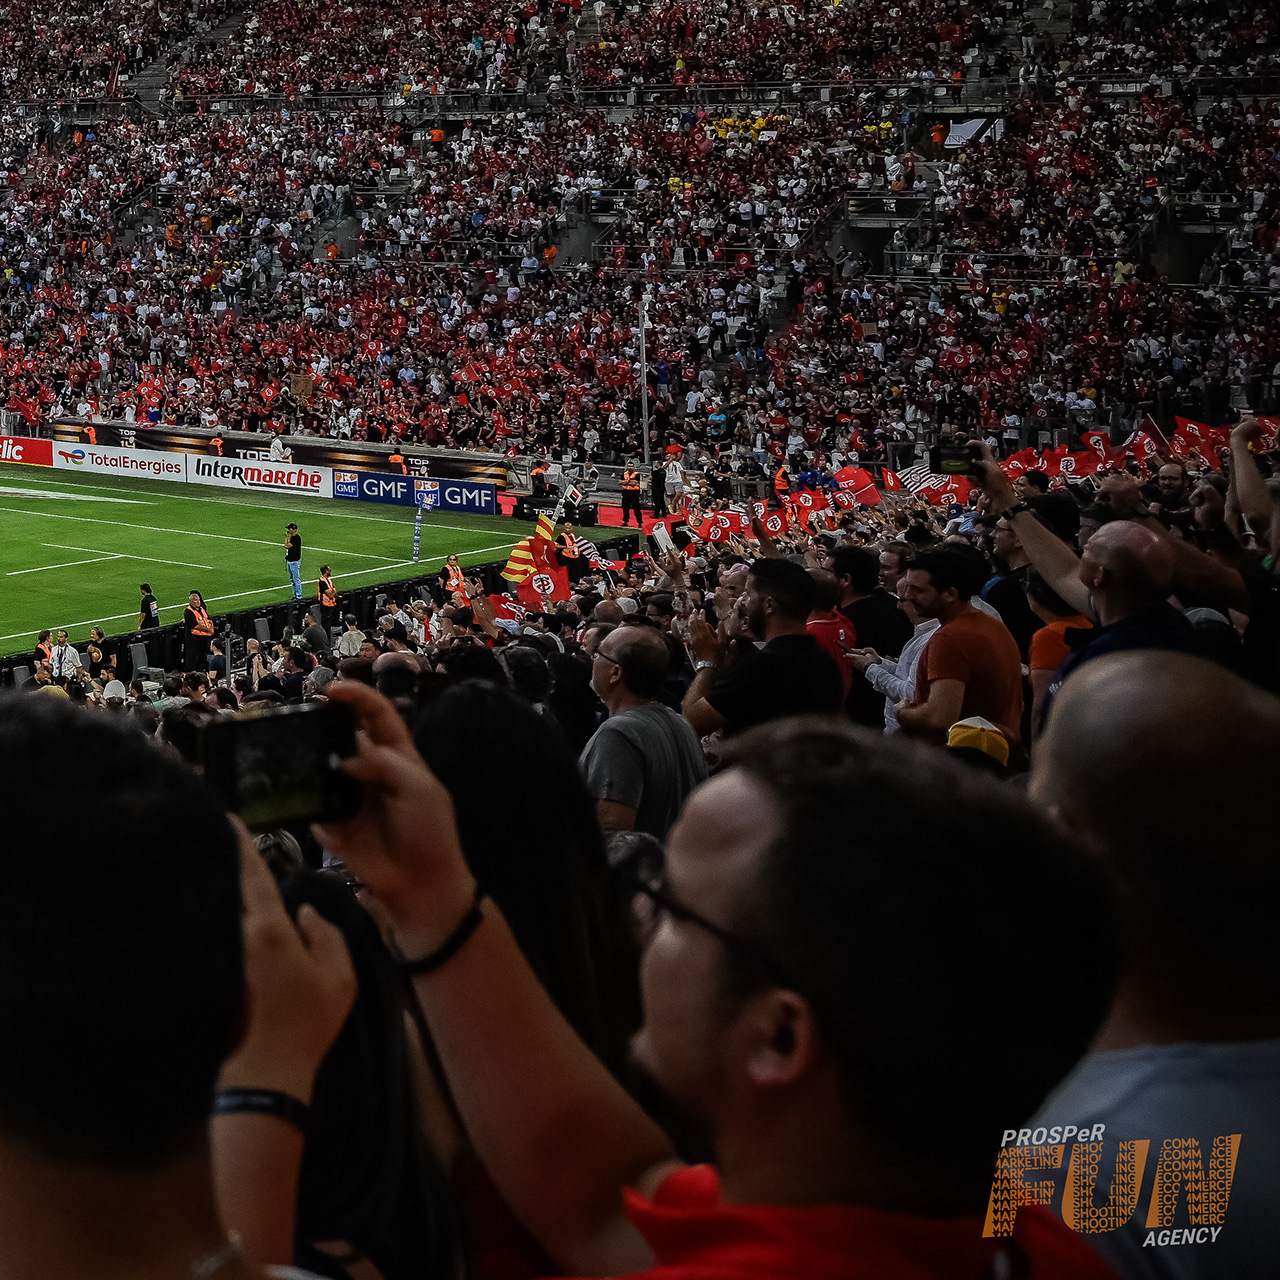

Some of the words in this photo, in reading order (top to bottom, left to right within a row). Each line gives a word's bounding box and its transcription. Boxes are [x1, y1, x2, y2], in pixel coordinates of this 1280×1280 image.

[88, 452, 181, 475] TotalEnergies
[336, 484, 357, 494] GMF
[363, 478, 407, 499] GMF
[445, 487, 491, 508] GMF
